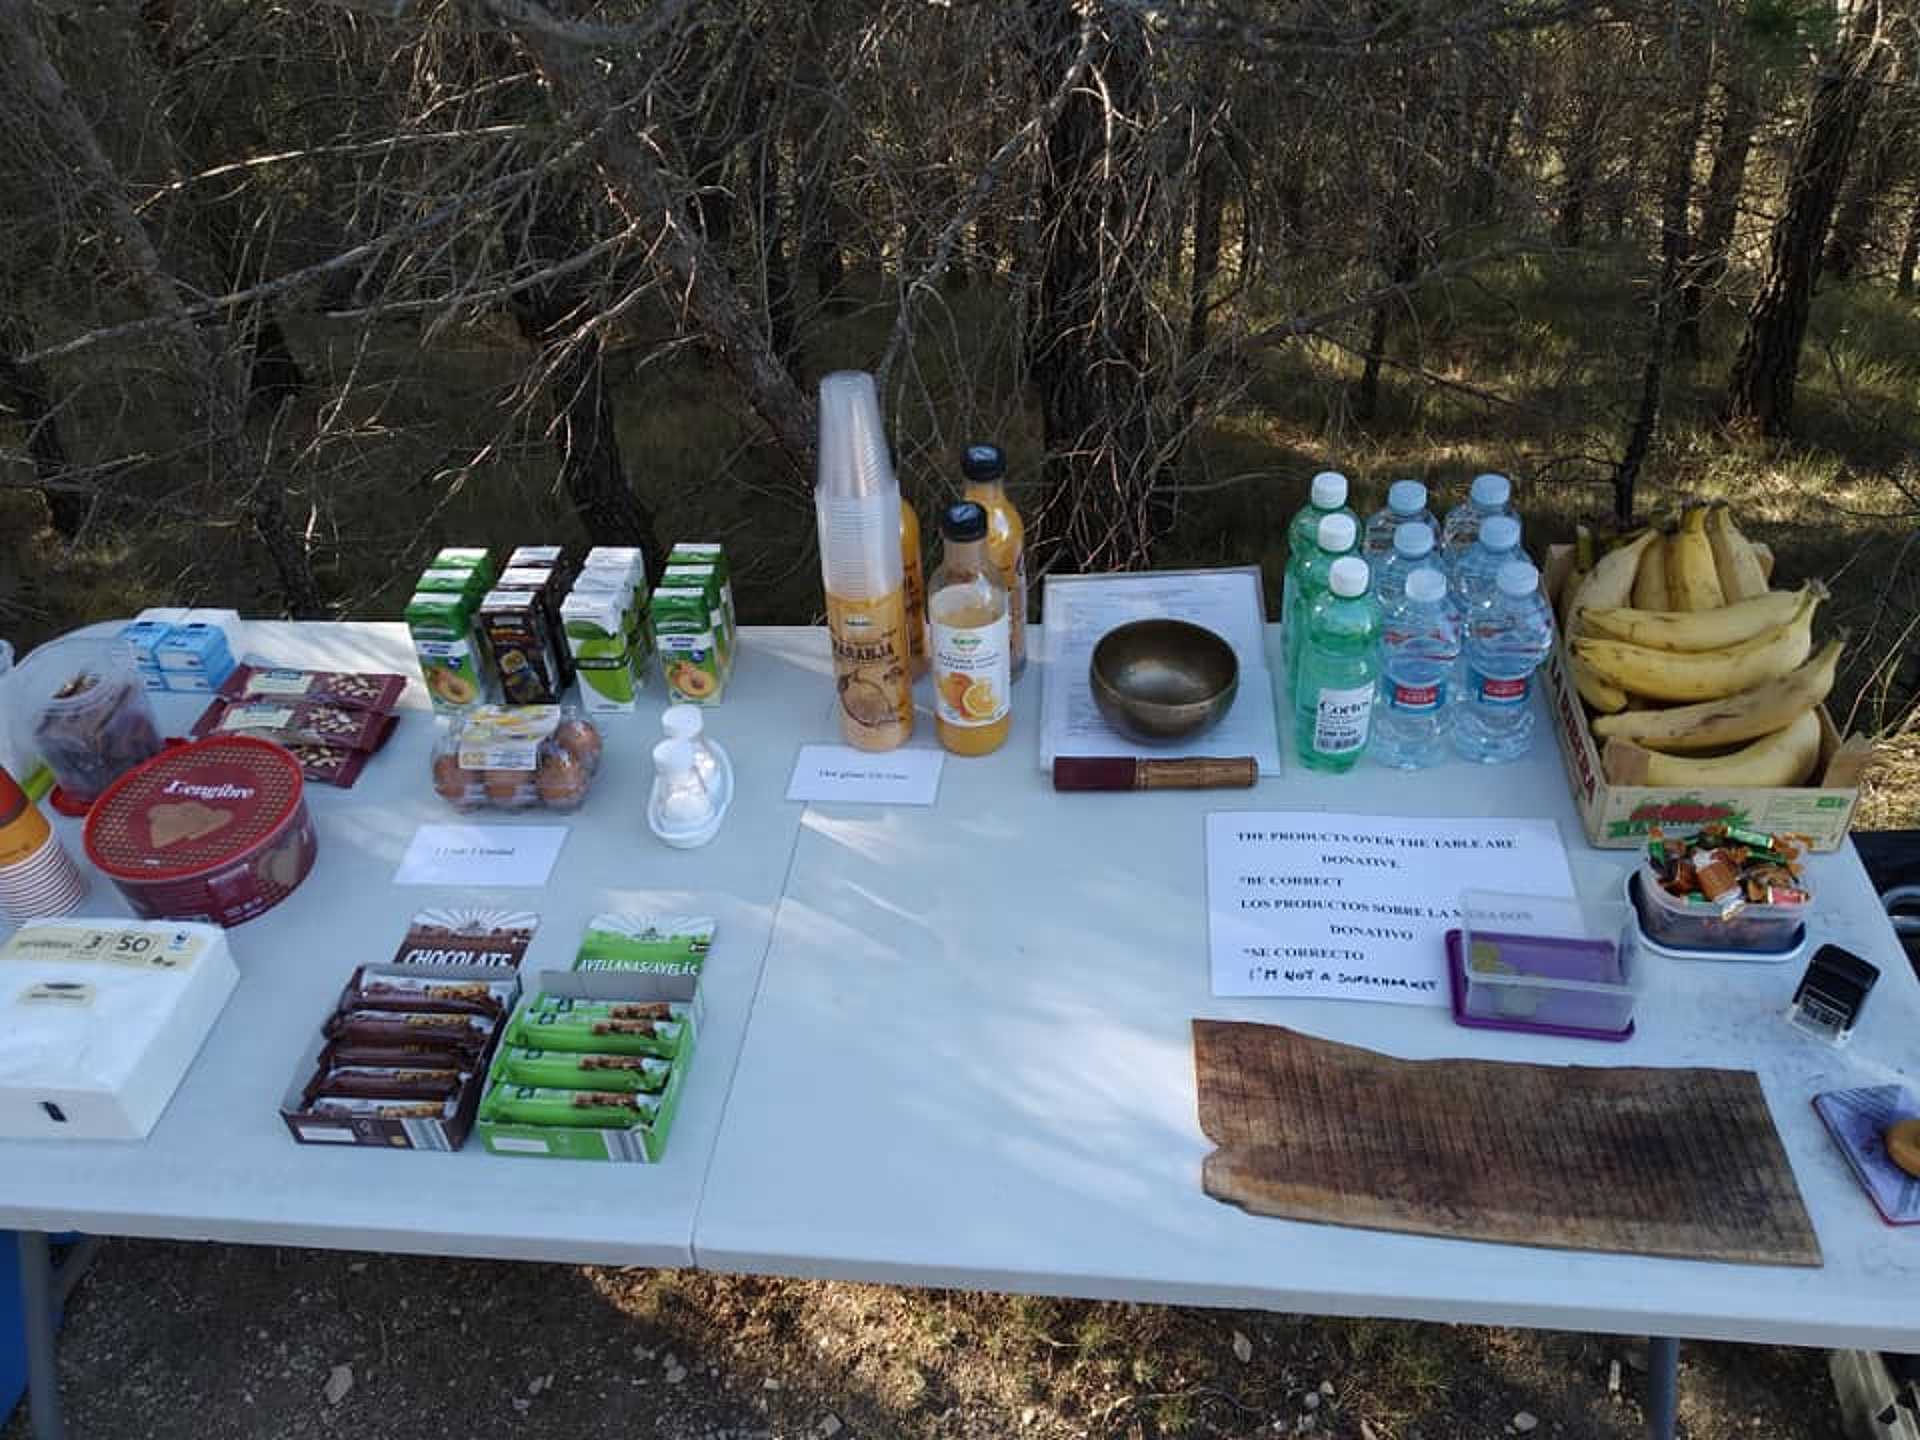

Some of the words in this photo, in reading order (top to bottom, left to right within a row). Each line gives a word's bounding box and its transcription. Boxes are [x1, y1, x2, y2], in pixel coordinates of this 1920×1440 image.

[1236, 832, 1264, 842] THE
[1269, 831, 1351, 844] PRODUCTS
[1352, 834, 1396, 847] OVER
[1398, 837, 1428, 848] THE
[1431, 838, 1483, 849] TABLE
[1486, 839, 1518, 849] ARE
[1321, 855, 1405, 869] DONATIVE
[1269, 876, 1344, 887] CORRECT
[1240, 899, 1271, 910] LOS
[1274, 899, 1370, 913] PRODUCTOS
[1372, 903, 1425, 918] SOBRE
[1427, 907, 1450, 919] LA
[1329, 924, 1415, 941] DONATIVO
[116, 934, 152, 954] 50
[404, 949, 513, 967] CHOCOLATE
[1273, 947, 1366, 961] CORRECTO
[1283, 968, 1315, 982] NOT
[1319, 972, 1332, 982] A
